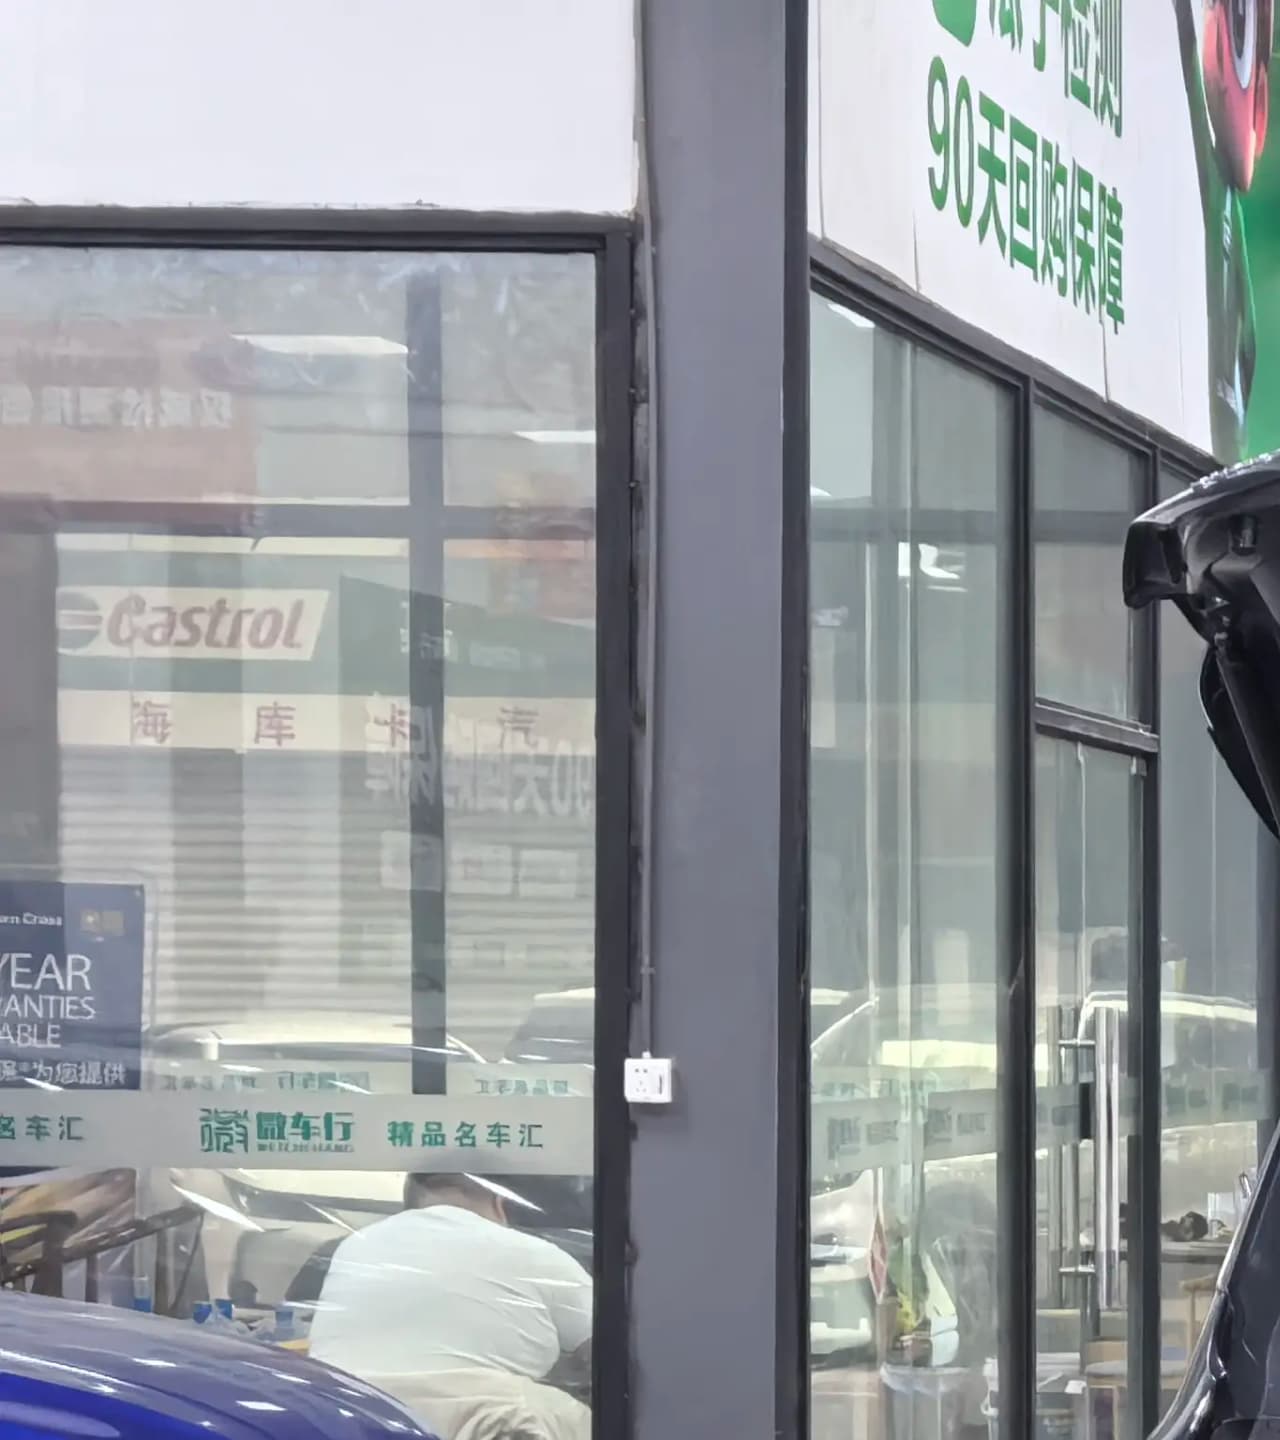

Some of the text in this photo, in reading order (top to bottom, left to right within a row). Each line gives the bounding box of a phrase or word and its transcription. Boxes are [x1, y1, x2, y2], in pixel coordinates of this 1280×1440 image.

[927, 55, 1125, 335] 90天回购保障
[107, 593, 305, 650] Castrol
[386, 1120, 544, 1149] 精品名车汇
